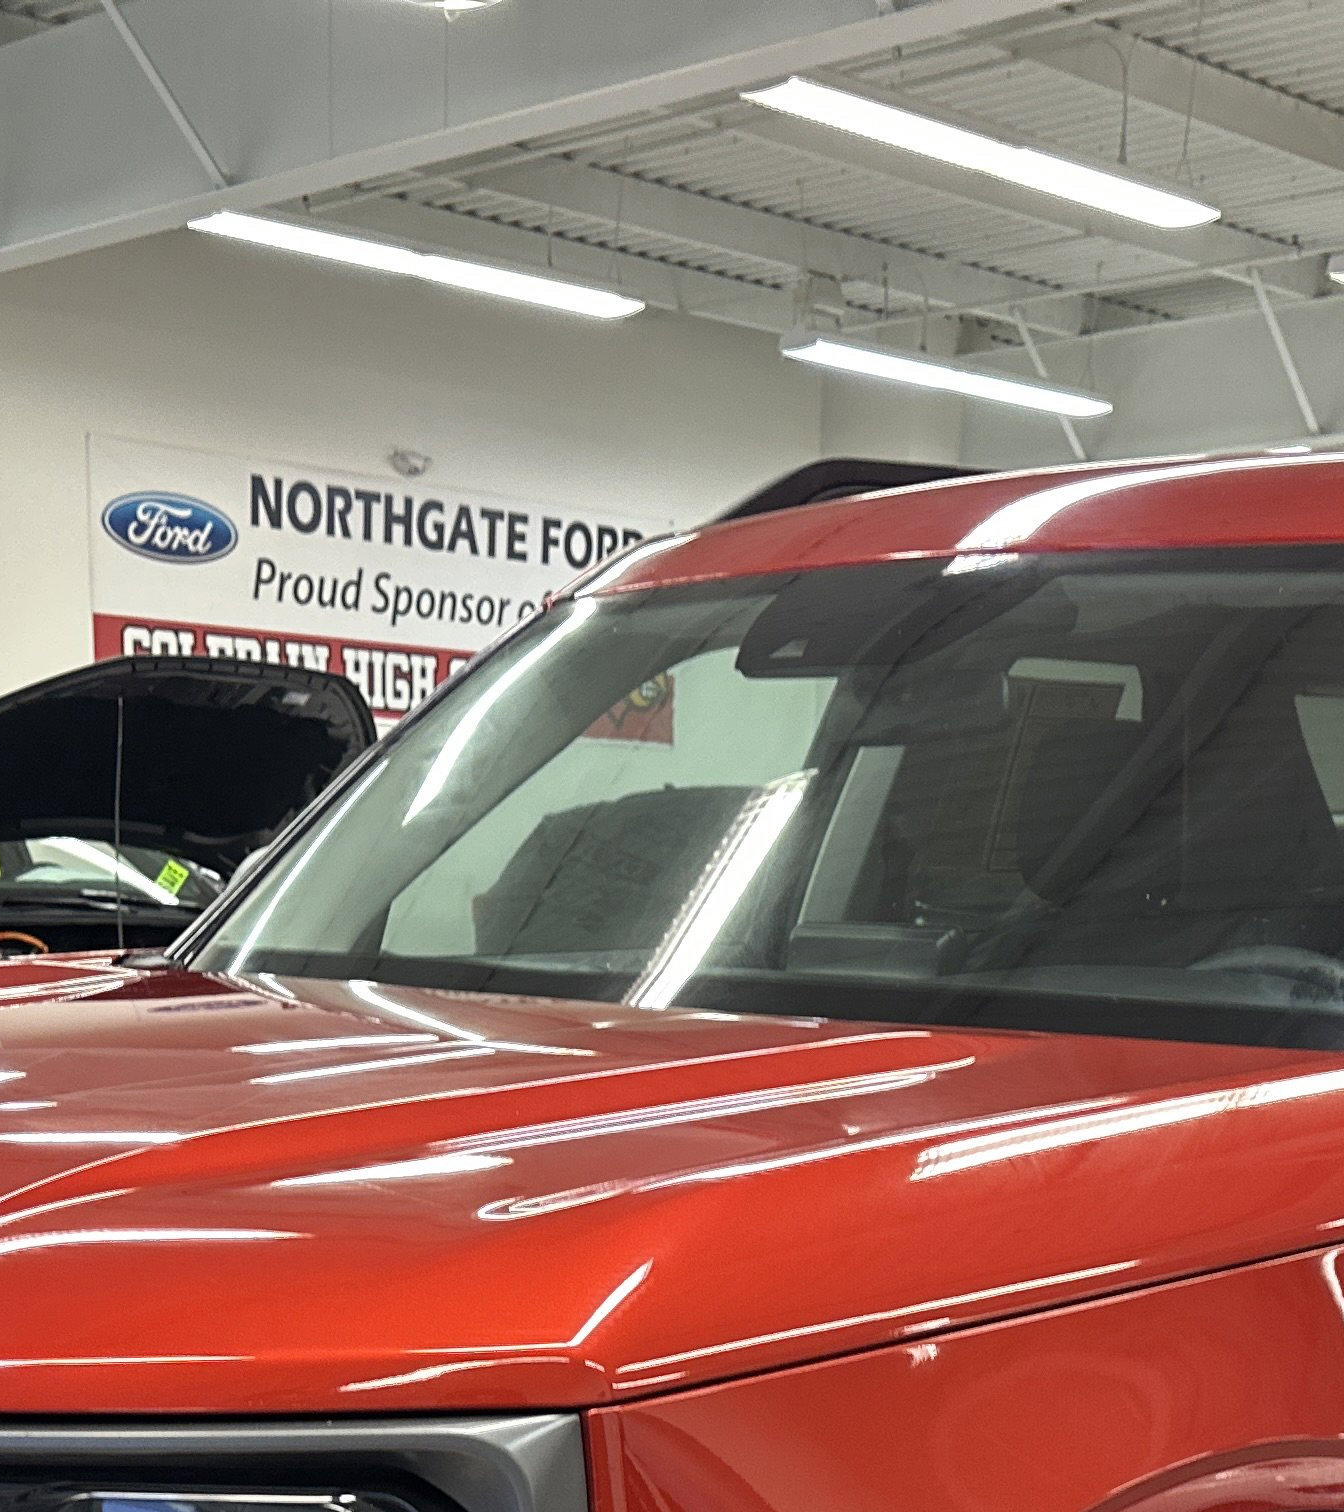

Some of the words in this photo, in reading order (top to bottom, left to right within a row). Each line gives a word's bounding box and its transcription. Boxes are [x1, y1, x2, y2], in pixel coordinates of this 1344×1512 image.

[127, 500, 213, 555] Ford
[249, 472, 529, 563] NORTHGATE
[253, 556, 364, 612] Proud
[371, 571, 514, 628] Sponsor
[342, 646, 437, 711] HIGH
